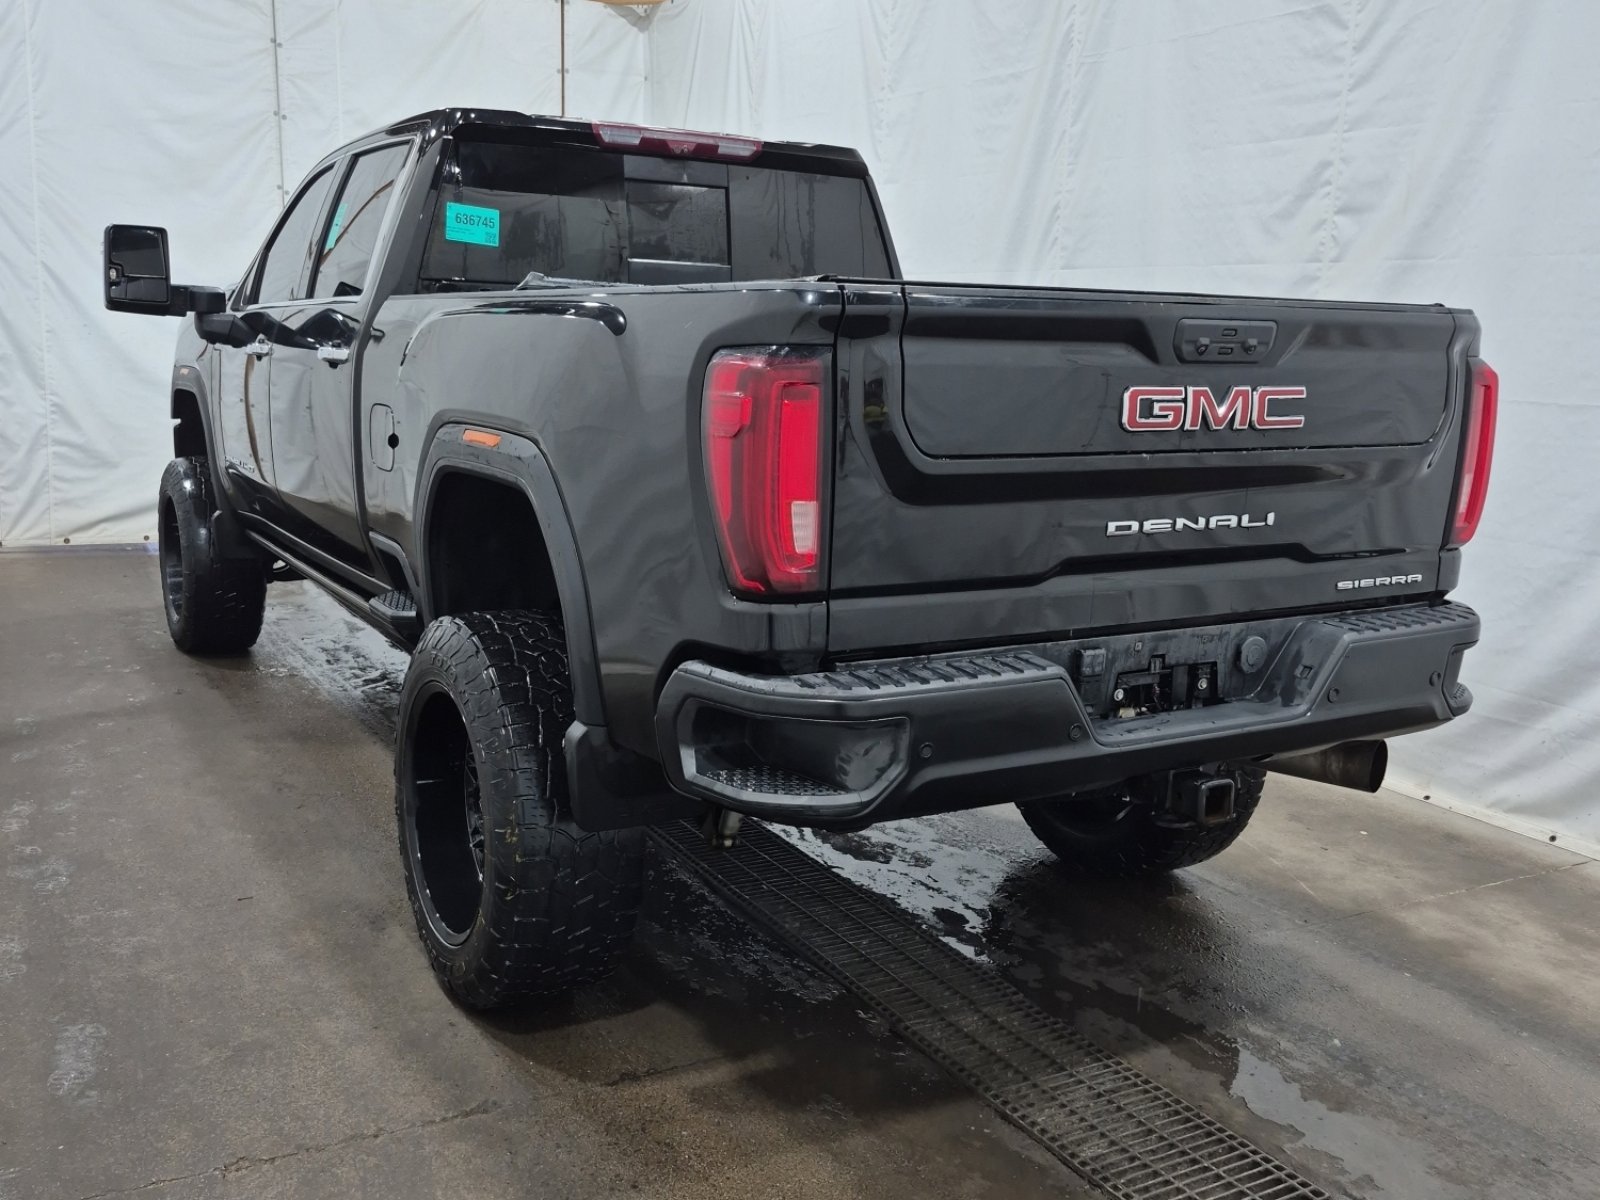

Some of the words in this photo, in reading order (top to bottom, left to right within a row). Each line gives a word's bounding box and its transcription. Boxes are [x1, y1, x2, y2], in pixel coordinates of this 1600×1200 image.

[455, 212, 495, 229] 636745
[1122, 385, 1307, 432] GMC
[1106, 511, 1276, 537] DENALI
[1335, 573, 1423, 591] SIERRA
